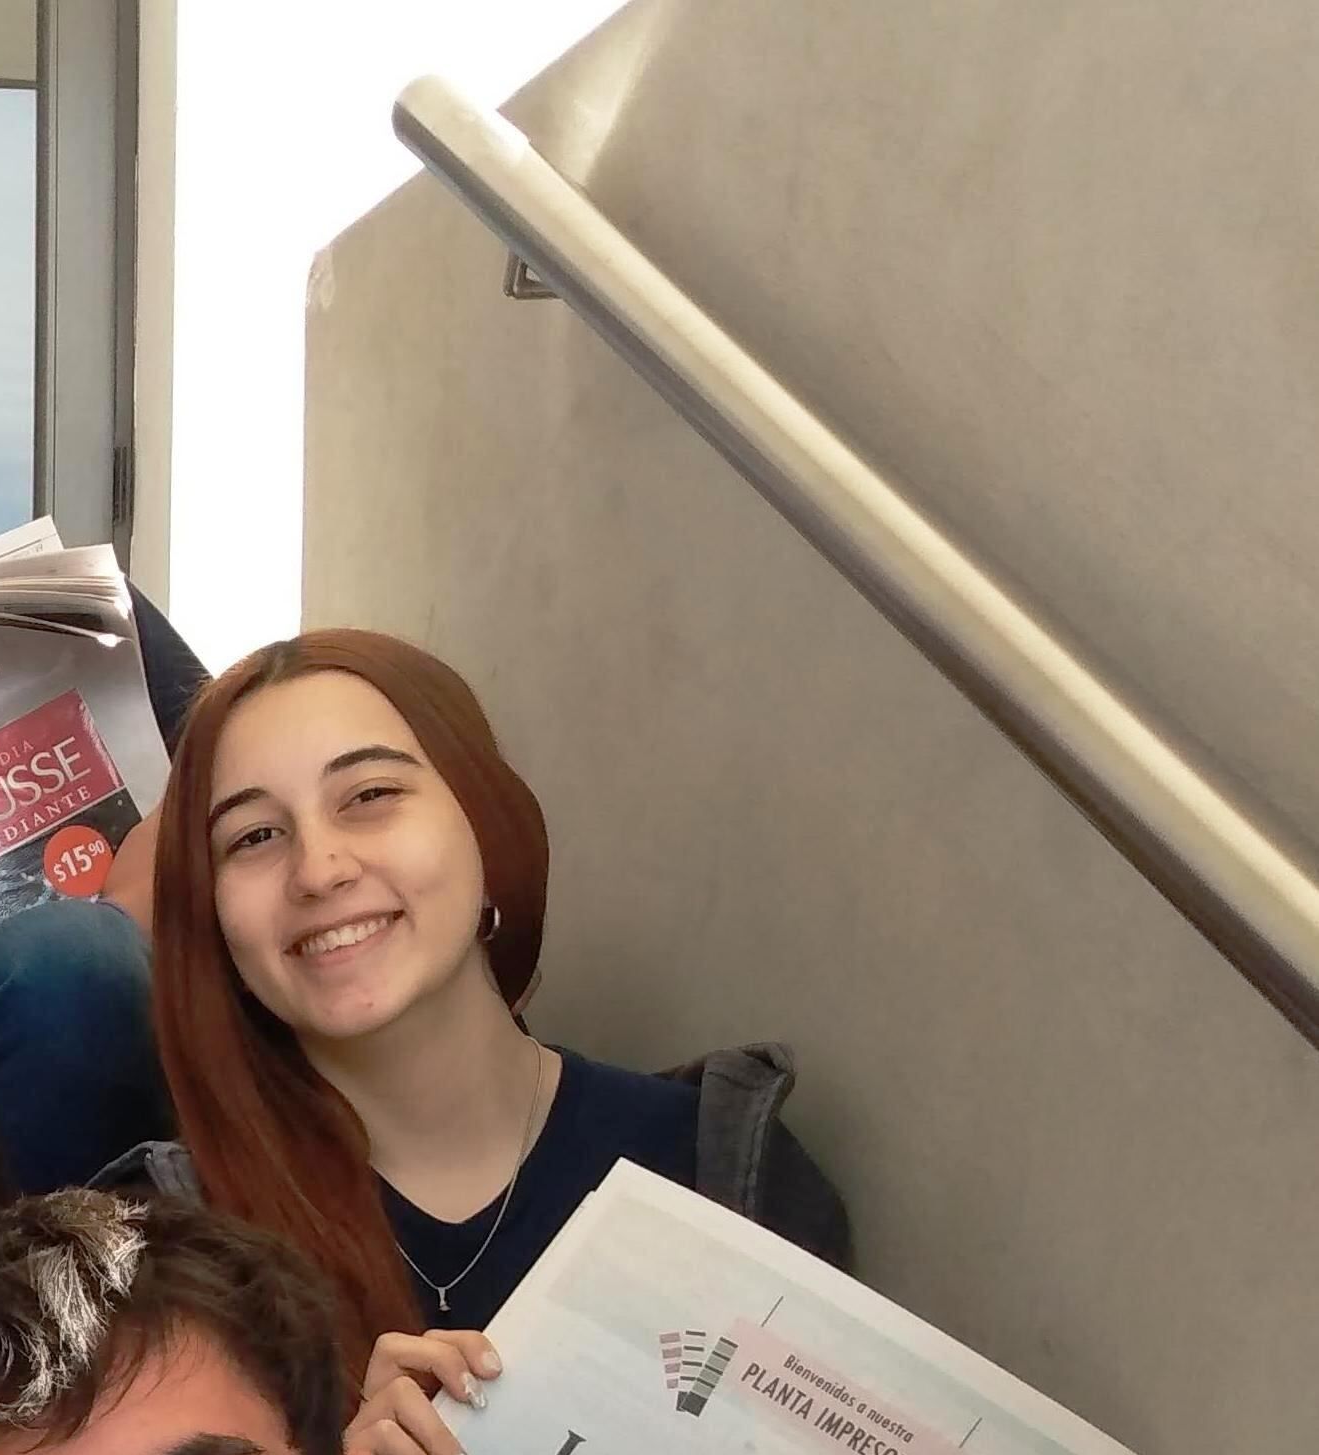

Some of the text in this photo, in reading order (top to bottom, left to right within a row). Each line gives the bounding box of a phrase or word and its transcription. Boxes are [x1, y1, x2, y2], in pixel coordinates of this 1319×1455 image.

[741, 1362, 814, 1420] PLANTA
[783, 1354, 914, 1443] Bienvenidos a nuestra
